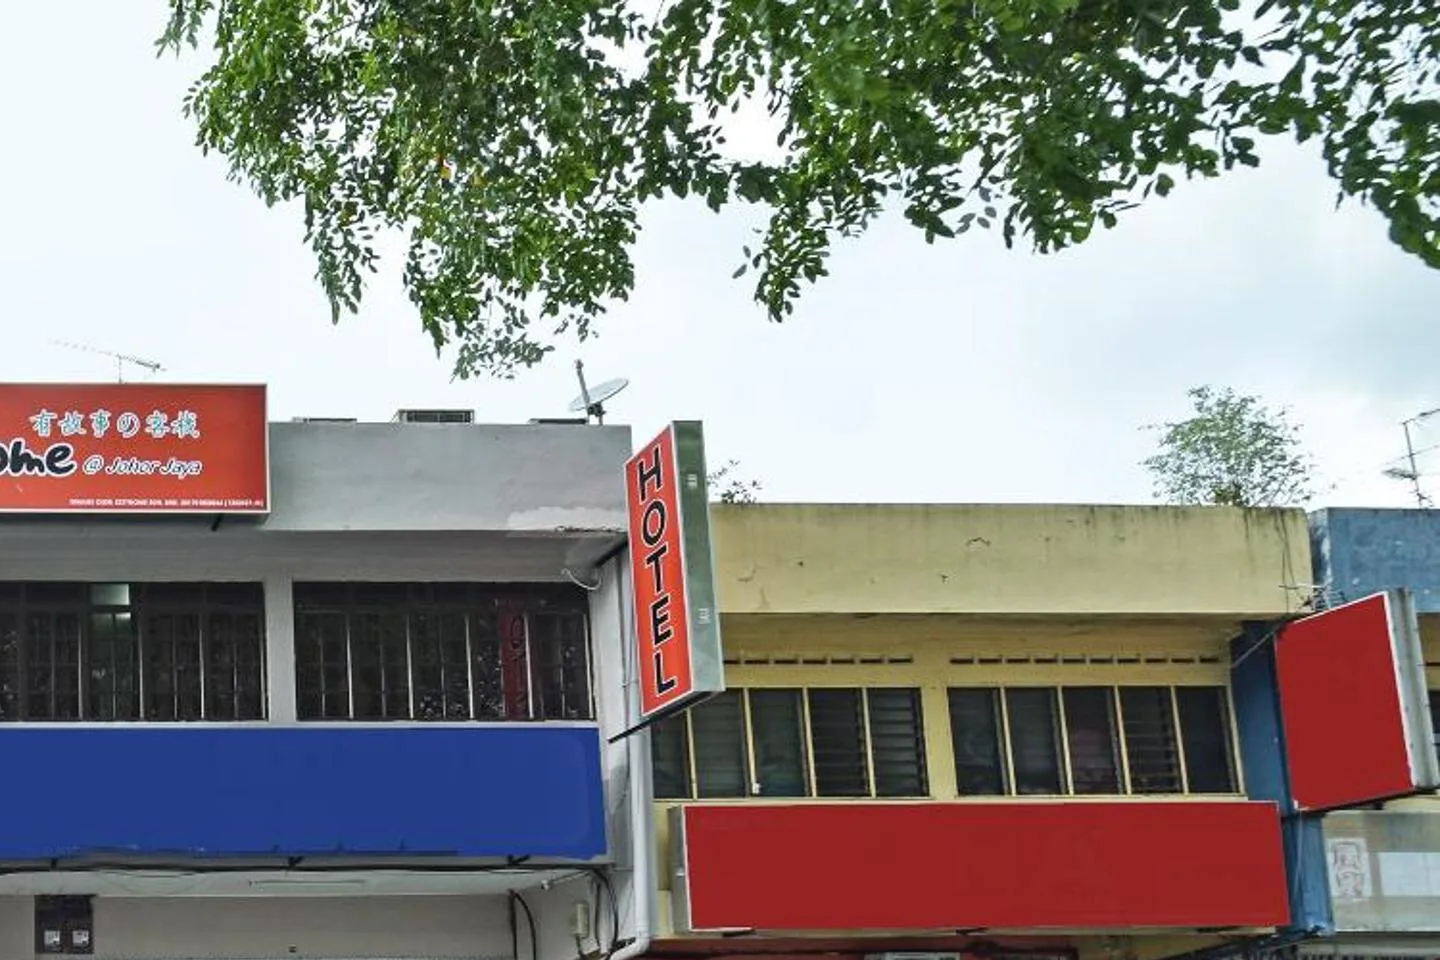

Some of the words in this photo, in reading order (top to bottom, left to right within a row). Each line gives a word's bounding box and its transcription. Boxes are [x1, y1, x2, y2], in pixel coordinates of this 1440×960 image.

[105, 456, 160, 476] Johor
[160, 456, 203, 480] Jaya
[636, 443, 678, 698] HOTEL
